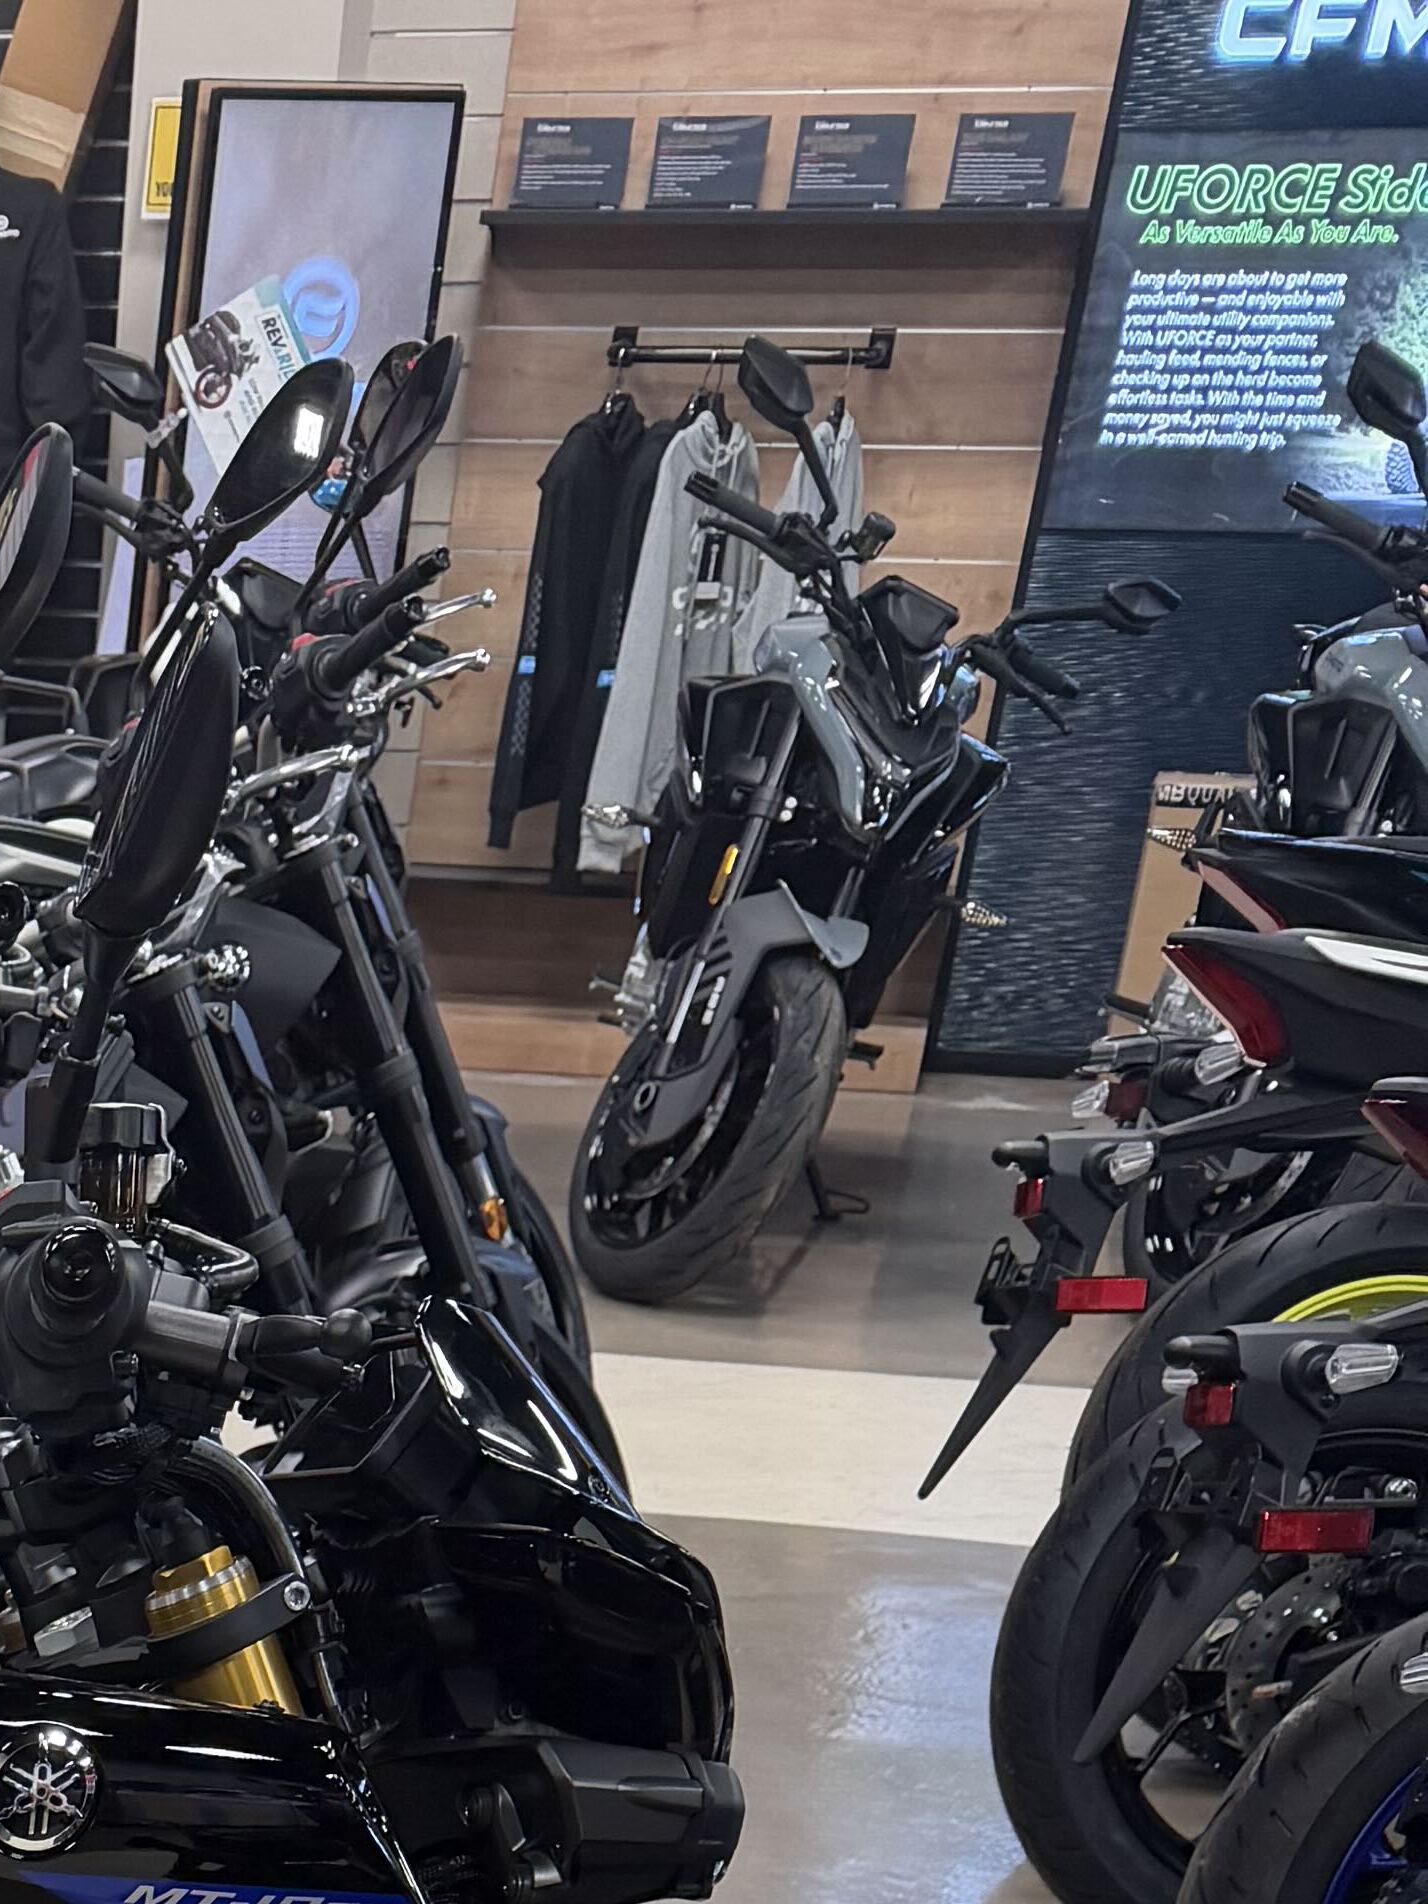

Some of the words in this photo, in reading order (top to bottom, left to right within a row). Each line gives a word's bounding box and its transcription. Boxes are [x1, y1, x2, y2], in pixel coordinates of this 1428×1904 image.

[1126, 163, 1342, 214] UFORCE
[1140, 219, 1170, 244] As
[1174, 218, 1272, 244] Versatile
[1274, 218, 1304, 244] As
[1310, 218, 1350, 244] You
[1351, 218, 1400, 244] Are.
[1130, 269, 1167, 290] Long
[1167, 269, 1200, 290] days
[1202, 272, 1225, 286] are
[1227, 269, 1270, 286] about
[1270, 271, 1285, 286] to
[1286, 271, 1311, 290] get
[1312, 272, 1349, 286] more
[1125, 290, 1200, 310] productive
[1217, 289, 1247, 307] and
[1247, 290, 1314, 310] enjoyable
[1316, 289, 1346, 307] with
[1124, 313, 1157, 330] your
[1157, 311, 1211, 327] ultimate
[1212, 311, 1251, 330] utility
[1122, 330, 1154, 346] With
[1155, 330, 1216, 346] UFORCE
[1216, 334, 1232, 346] as
[1234, 334, 1266, 350] your
[1266, 332, 1319, 350] partner,
[1115, 351, 1166, 371] hauling
[1203, 351, 1262, 372] mending
[1311, 354, 1328, 367] or
[1111, 369, 1170, 391] checking
[1171, 373, 1190, 390] up
[1192, 373, 1210, 387] on
[1211, 370, 1233, 387] the
[1234, 370, 1268, 387] herd
[1268, 370, 1322, 387] become
[1106, 389, 1168, 408] effortless
[1207, 390, 1240, 407] With
[1241, 391, 1264, 407] the
[1265, 391, 1295, 407] time
[1297, 390, 1327, 408] and
[1102, 412, 1149, 430] money
[1194, 413, 1219, 429] you
[1220, 411, 1260, 430] might
[1260, 411, 1285, 430] just
[1286, 414, 1341, 430] squeeze
[1208, 430, 1259, 450] hunting
[1260, 430, 1286, 450] trip.
